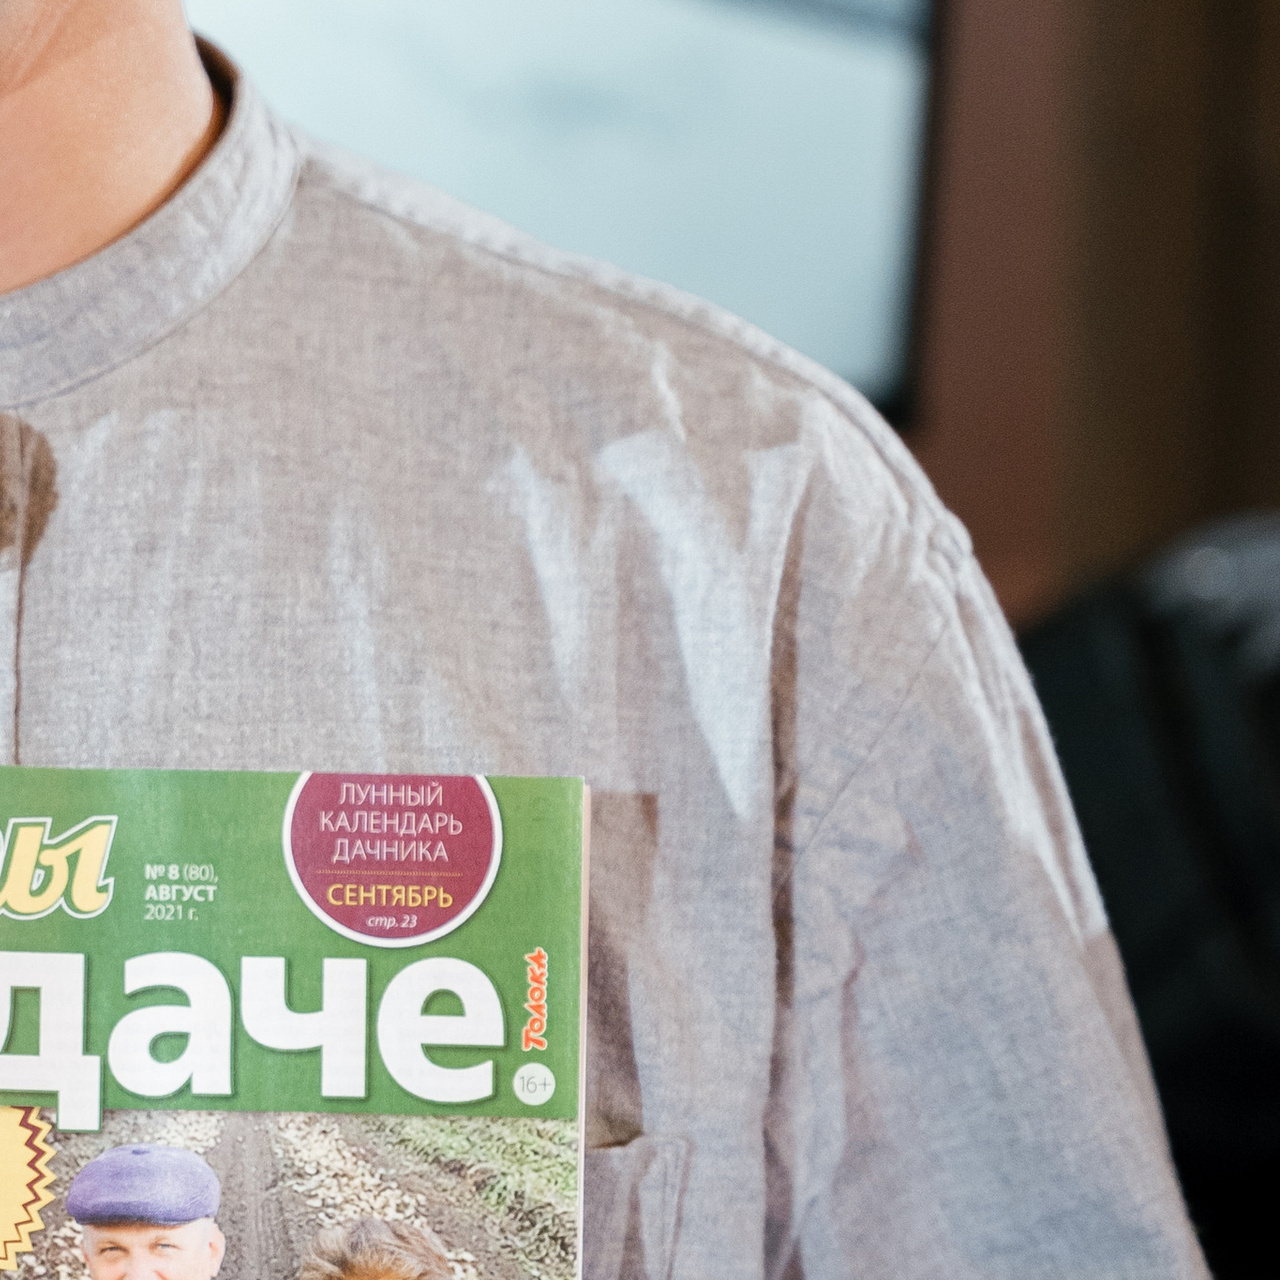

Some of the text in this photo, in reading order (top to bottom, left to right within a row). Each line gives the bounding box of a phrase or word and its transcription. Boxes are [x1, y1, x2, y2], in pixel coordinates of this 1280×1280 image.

[338, 780, 444, 807] ЛУННЫЙ
[320, 810, 464, 836] КАЛЕНДАРЬ
[332, 838, 449, 864] ДАЧНИКА
[168, 864, 180, 880] 8
[144, 885, 217, 902] АВГУСТ
[327, 883, 453, 908] СЕНТЯБРЬ
[143, 905, 183, 921] 2021
[365, 915, 417, 930] стр. 23
[518, 1075, 552, 1094] 16+
